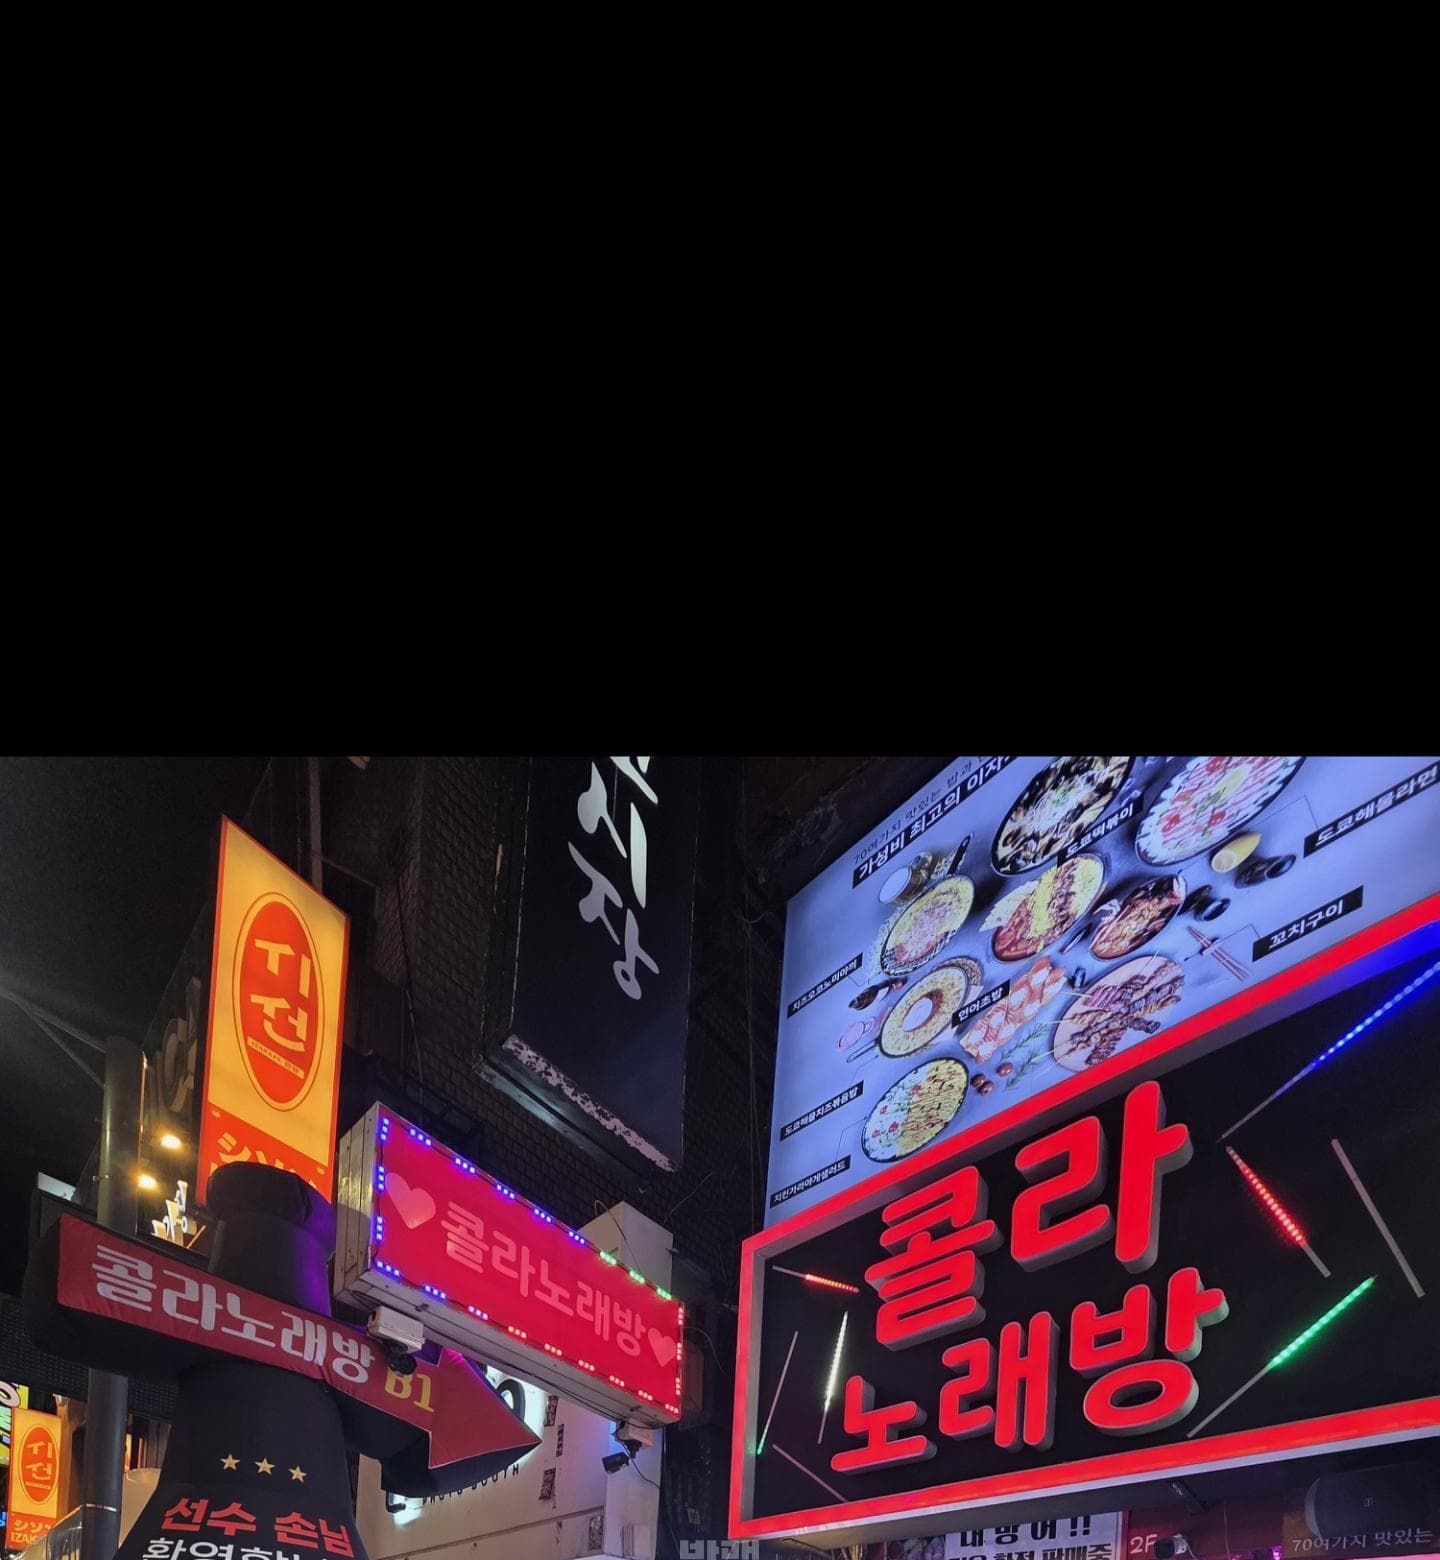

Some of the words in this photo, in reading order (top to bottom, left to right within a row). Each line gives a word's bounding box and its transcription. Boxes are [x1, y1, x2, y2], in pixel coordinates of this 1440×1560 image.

[571, 756, 660, 1001] 시장
[858, 834, 906, 879] 가성비
[909, 788, 961, 839] 최고의
[1269, 899, 1343, 950] 꼬치구이
[865, 1081, 1193, 1350] 콜라
[92, 1243, 376, 1384] 콜라노래방
[440, 1199, 647, 1358] 콜라노래방
[831, 1267, 1227, 1476] 노래방
[160, 1497, 257, 1537] 선수
[273, 1510, 356, 1558] 손님
[1130, 1533, 1158, 1555] 2F
[1291, 1534, 1368, 1552] 70여가지
[1375, 1527, 1433, 1547] 맛있는
